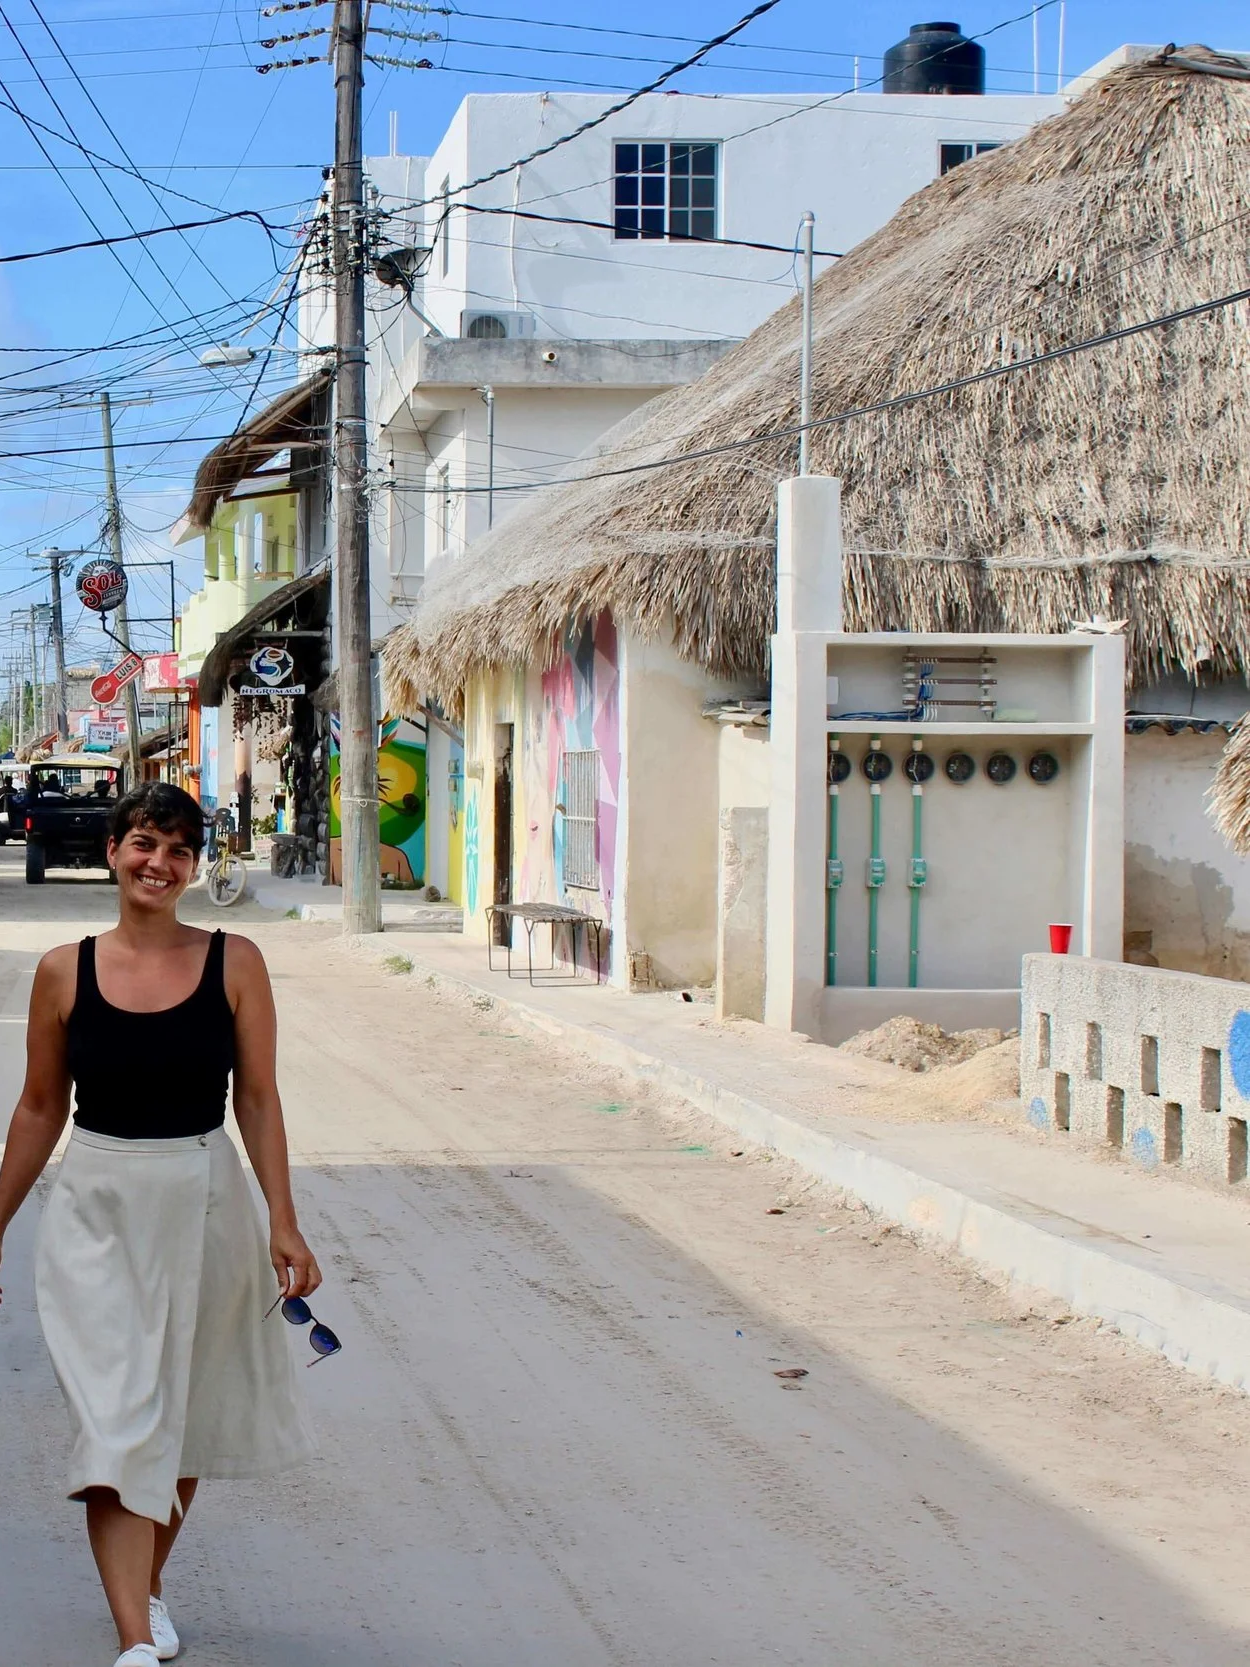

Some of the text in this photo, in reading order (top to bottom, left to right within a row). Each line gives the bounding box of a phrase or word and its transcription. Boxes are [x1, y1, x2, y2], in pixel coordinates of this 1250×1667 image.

[82, 570, 123, 609] SOL
[115, 662, 133, 680] LUIS
[241, 687, 302, 695] NEGROMACO
